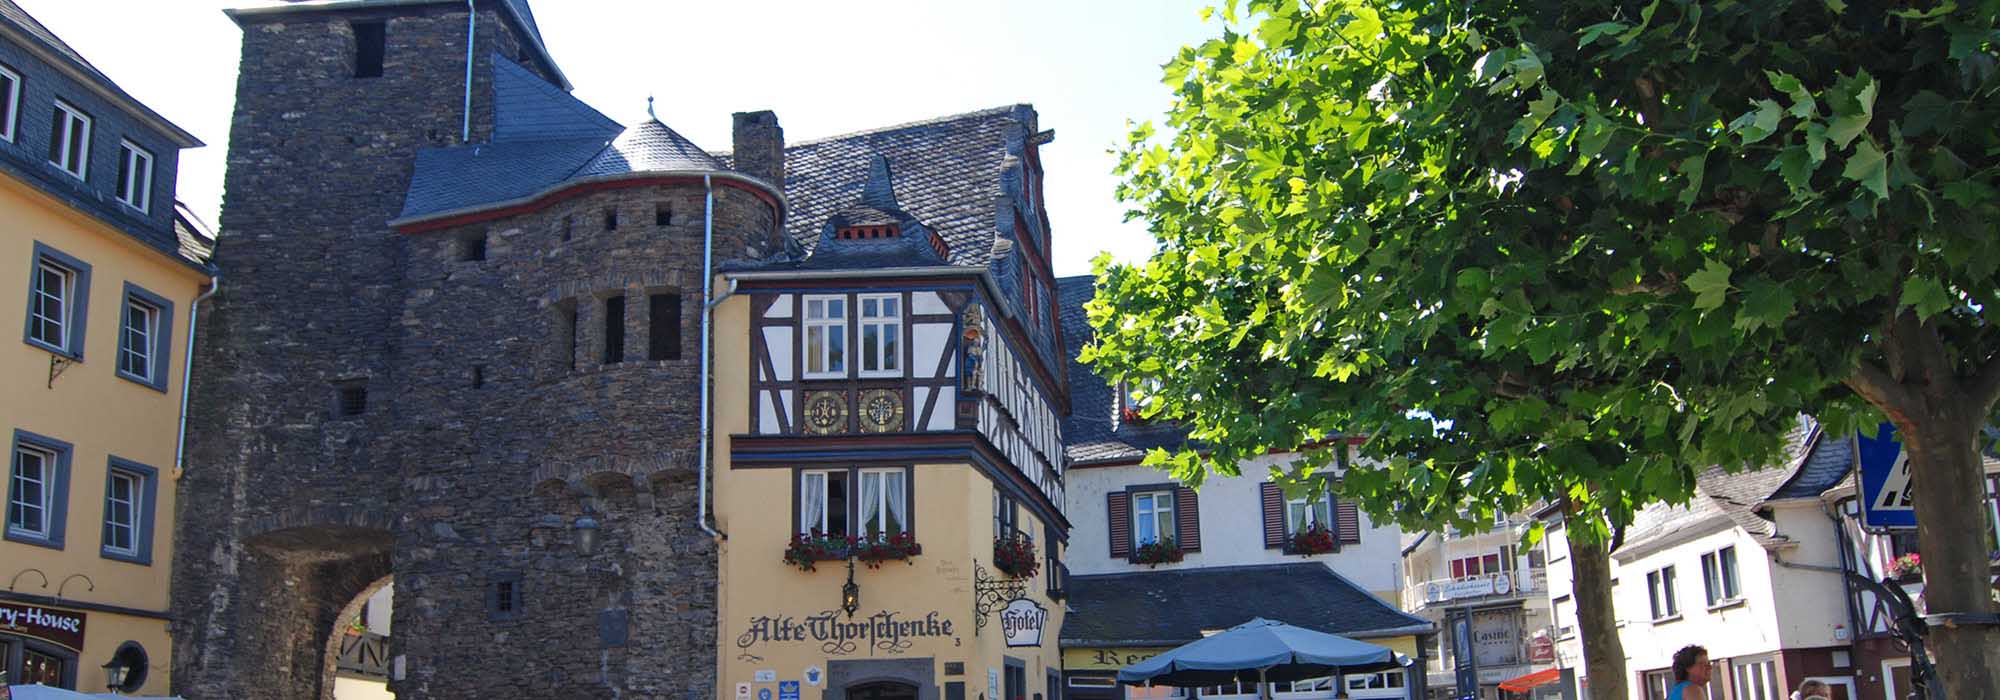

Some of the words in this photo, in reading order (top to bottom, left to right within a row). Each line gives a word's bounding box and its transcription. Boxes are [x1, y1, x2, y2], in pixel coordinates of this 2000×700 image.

[739, 613, 806, 650] Alte
[1004, 608, 1041, 639] Hotel
[954, 637, 961, 647] 3
